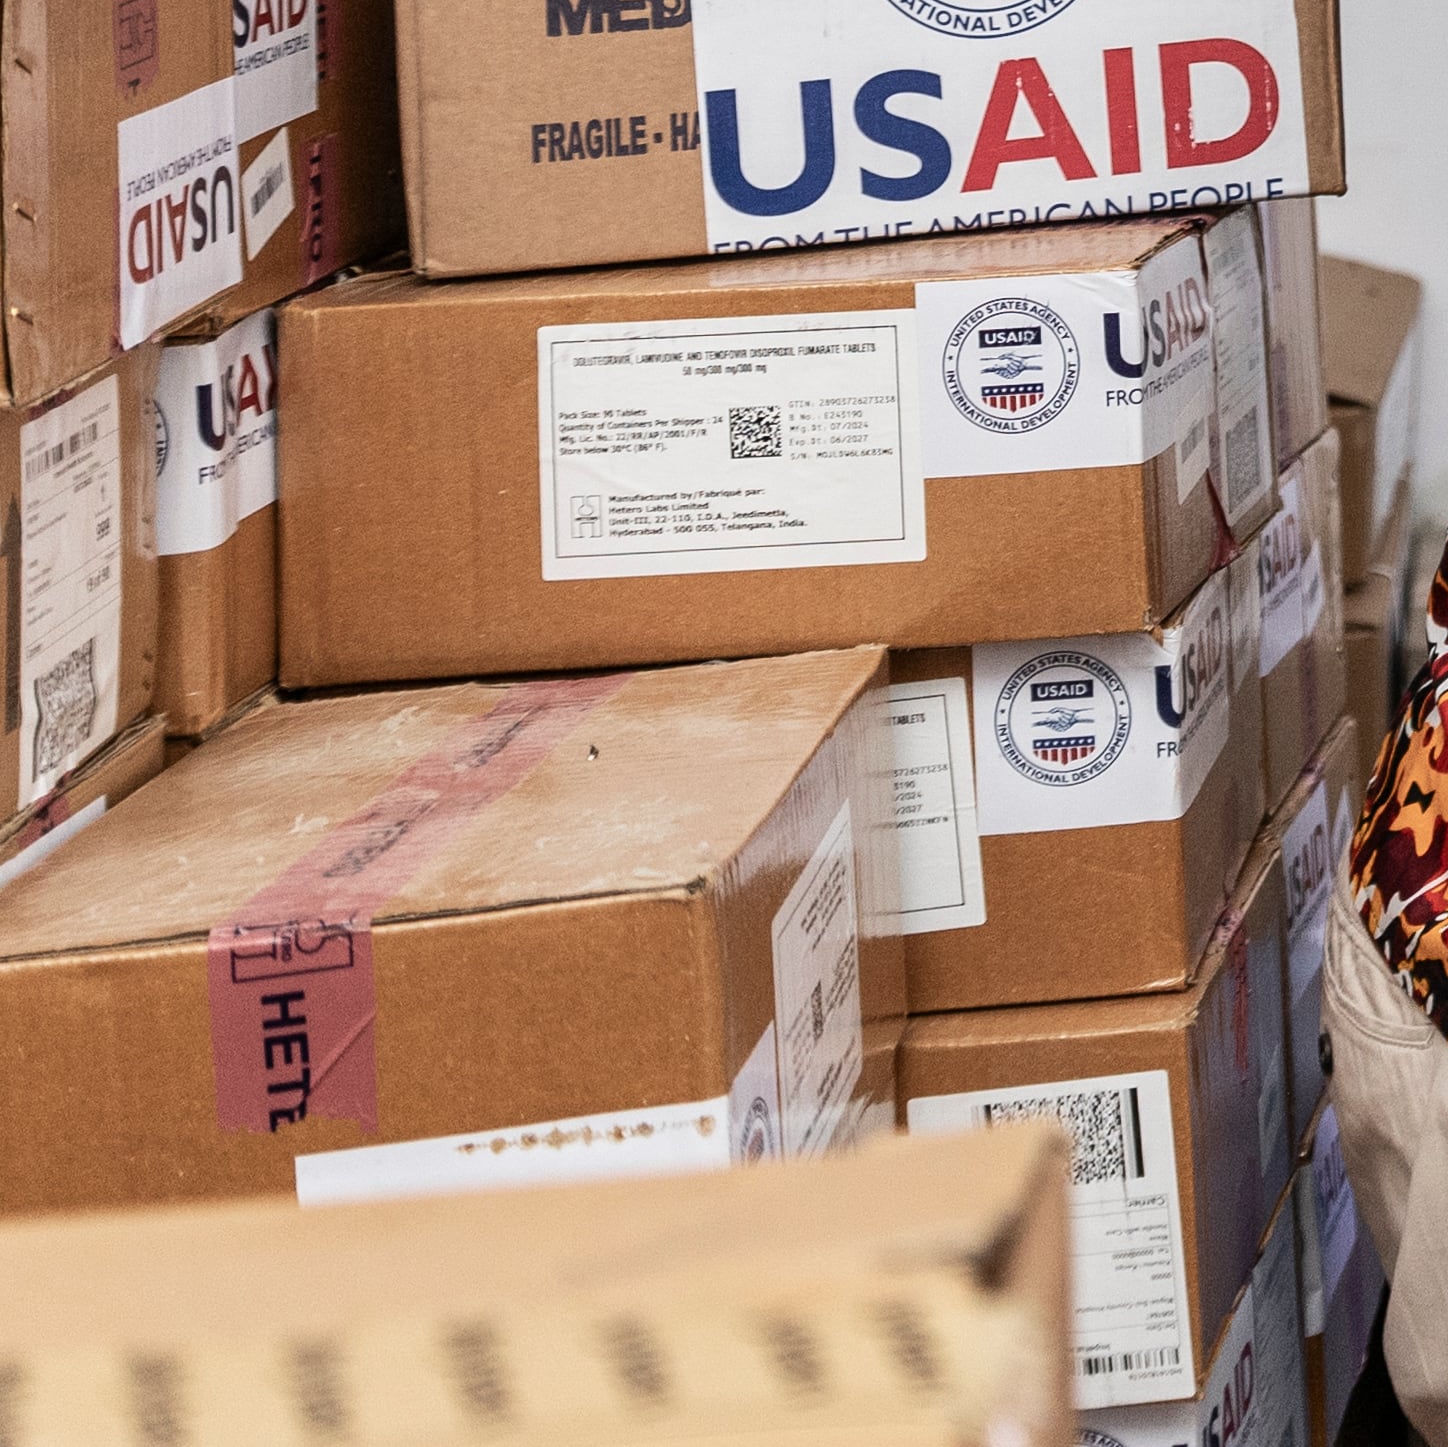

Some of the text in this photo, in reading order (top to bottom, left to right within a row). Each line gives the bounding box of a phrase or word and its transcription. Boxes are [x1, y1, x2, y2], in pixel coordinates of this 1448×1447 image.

[703, 38, 1282, 218] USAID
[531, 116, 649, 163] FRAGILE
[128, 165, 235, 285] USAID
[950, 301, 1071, 348] UNITED STATES AGENCY
[1103, 277, 1207, 379] USAID
[984, 331, 1038, 345] USAID
[573, 342, 877, 367] DOLUTEGRAVIR, LAMIVUDINE AND TENOFOVIR DISOPROXIL FUMARATE TABLETS
[755, 364, 767, 374] mg
[946, 361, 1077, 432] INTERNATIONAL DEVELOPMENT
[558, 411, 578, 420] Pack
[616, 408, 648, 418] Tablets
[558, 423, 595, 433] Quantity
[596, 421, 605, 430] of
[607, 419, 653, 430] Containers
[655, 419, 669, 427] Per
[671, 417, 706, 428] Shipper
[583, 444, 609, 454] below
[608, 493, 678, 504] Manufactured
[608, 501, 710, 515] Hetero Labs Limited
[608, 526, 664, 538] Hyderabad
[721, 519, 776, 532] Telangana,
[778, 518, 809, 530] India.
[1002, 654, 1123, 702] UNITED STATES AGENCY
[1037, 684, 1088, 699] USAID
[998, 714, 1129, 784] INTERNATIONAL DEVELOPMENT
[1127, 1195, 1166, 1208] Carrier
